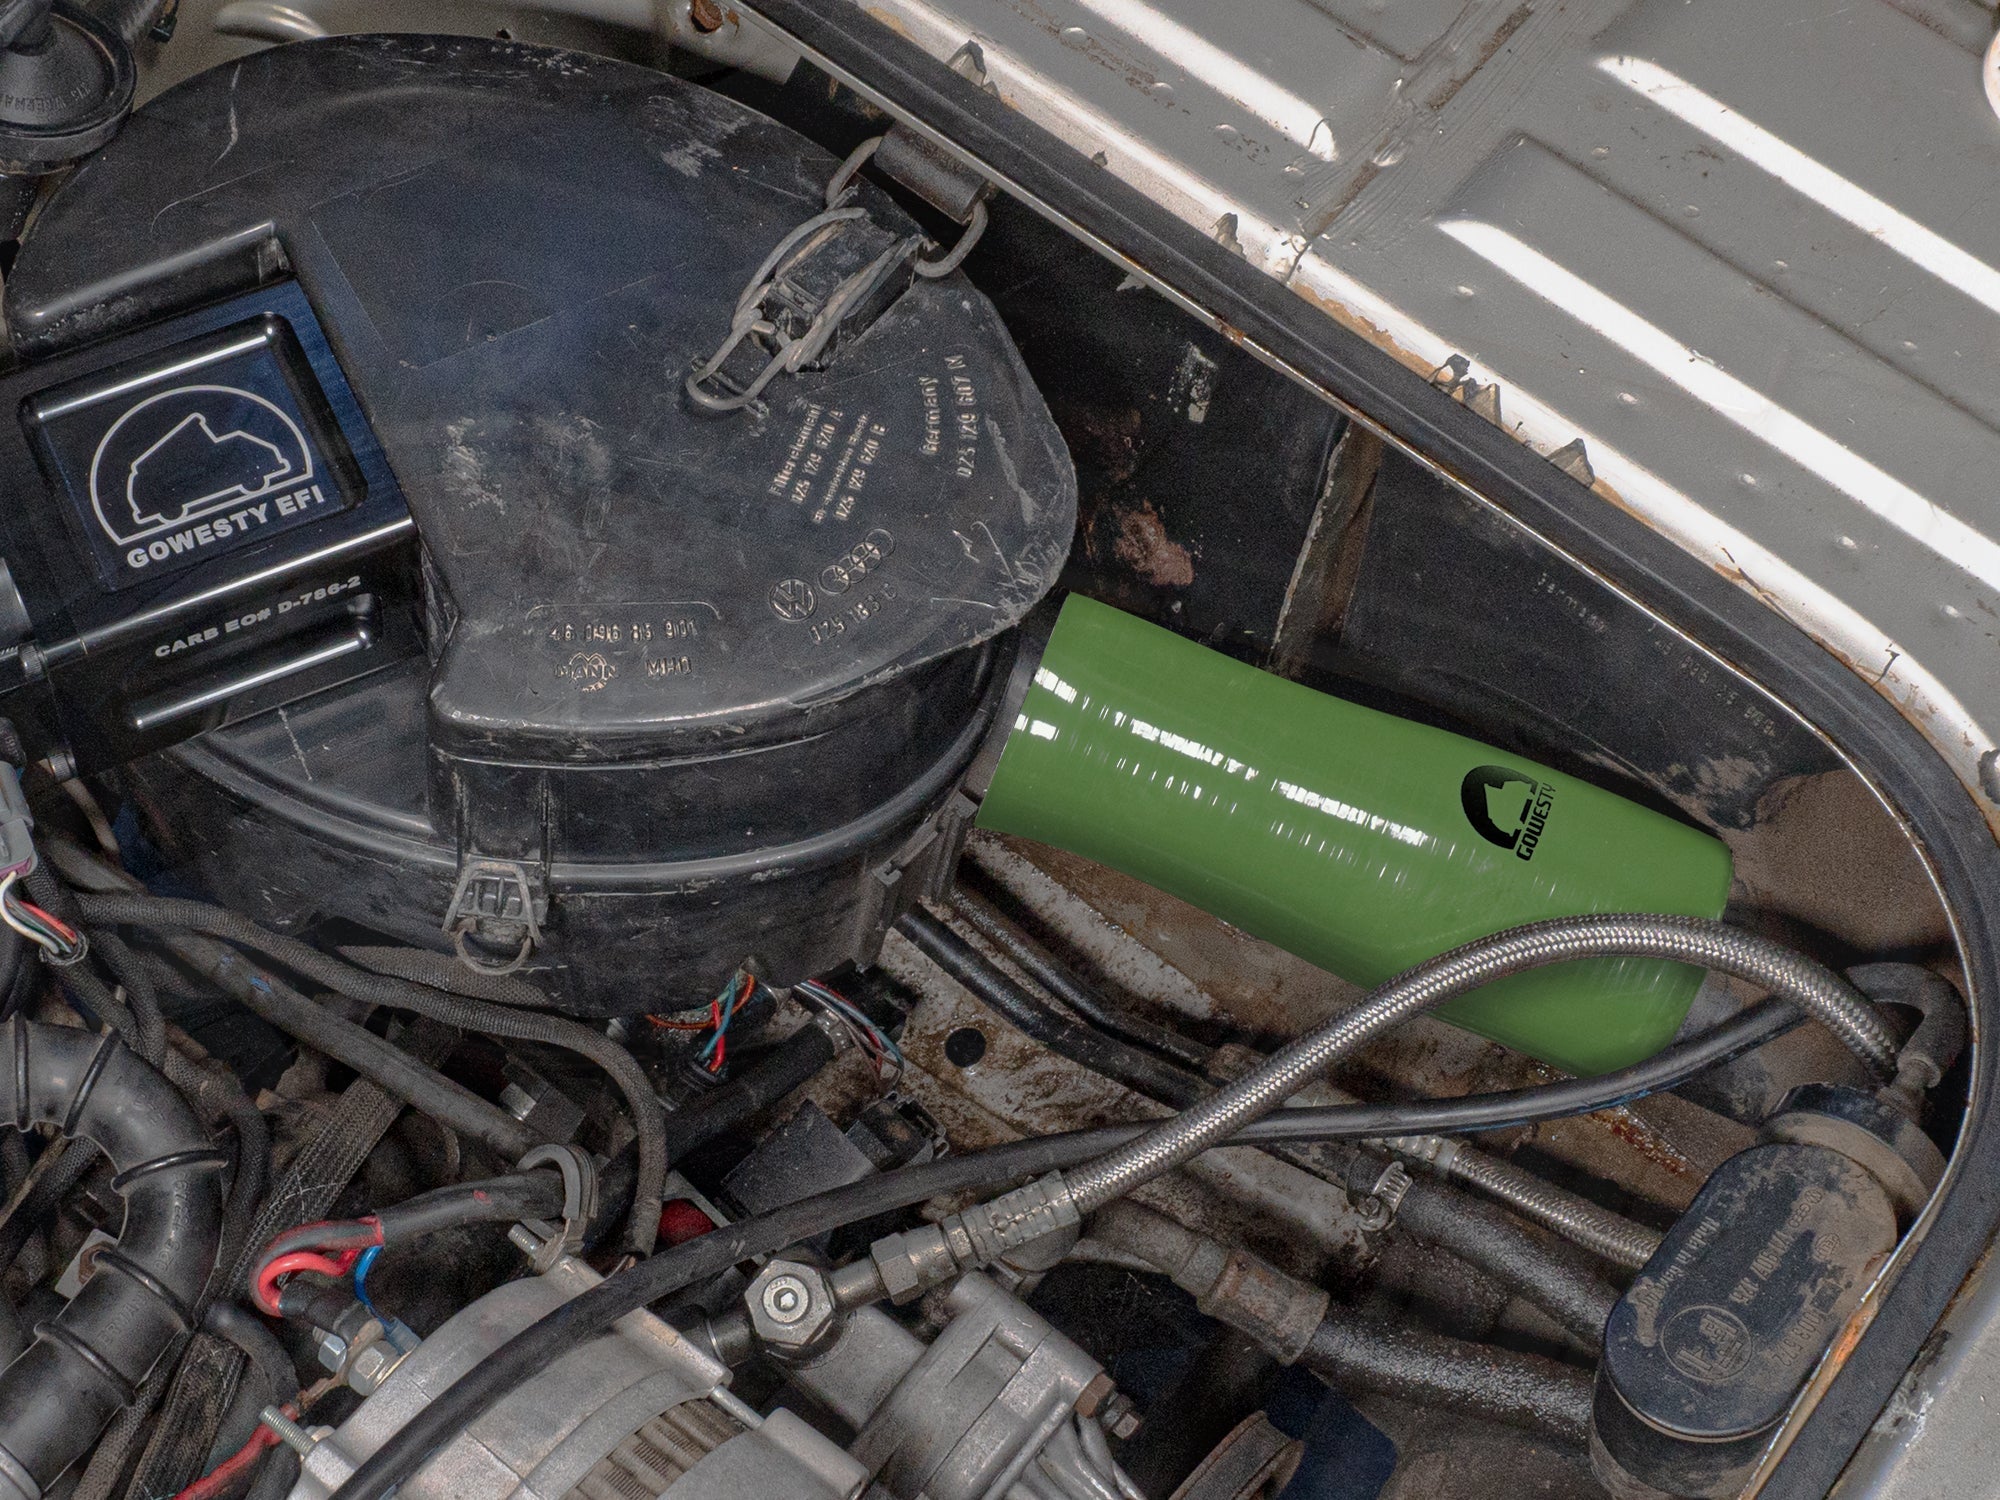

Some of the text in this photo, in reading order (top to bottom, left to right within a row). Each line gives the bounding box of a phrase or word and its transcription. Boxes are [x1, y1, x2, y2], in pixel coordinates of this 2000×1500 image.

[918, 376, 940, 455] Germany
[126, 484, 325, 569] GOWESTY EFI
[154, 575, 362, 658] CARB EO# D-786-2
[1515, 781, 1557, 862] GOWESTY
[1675, 1249, 1692, 1265] in
